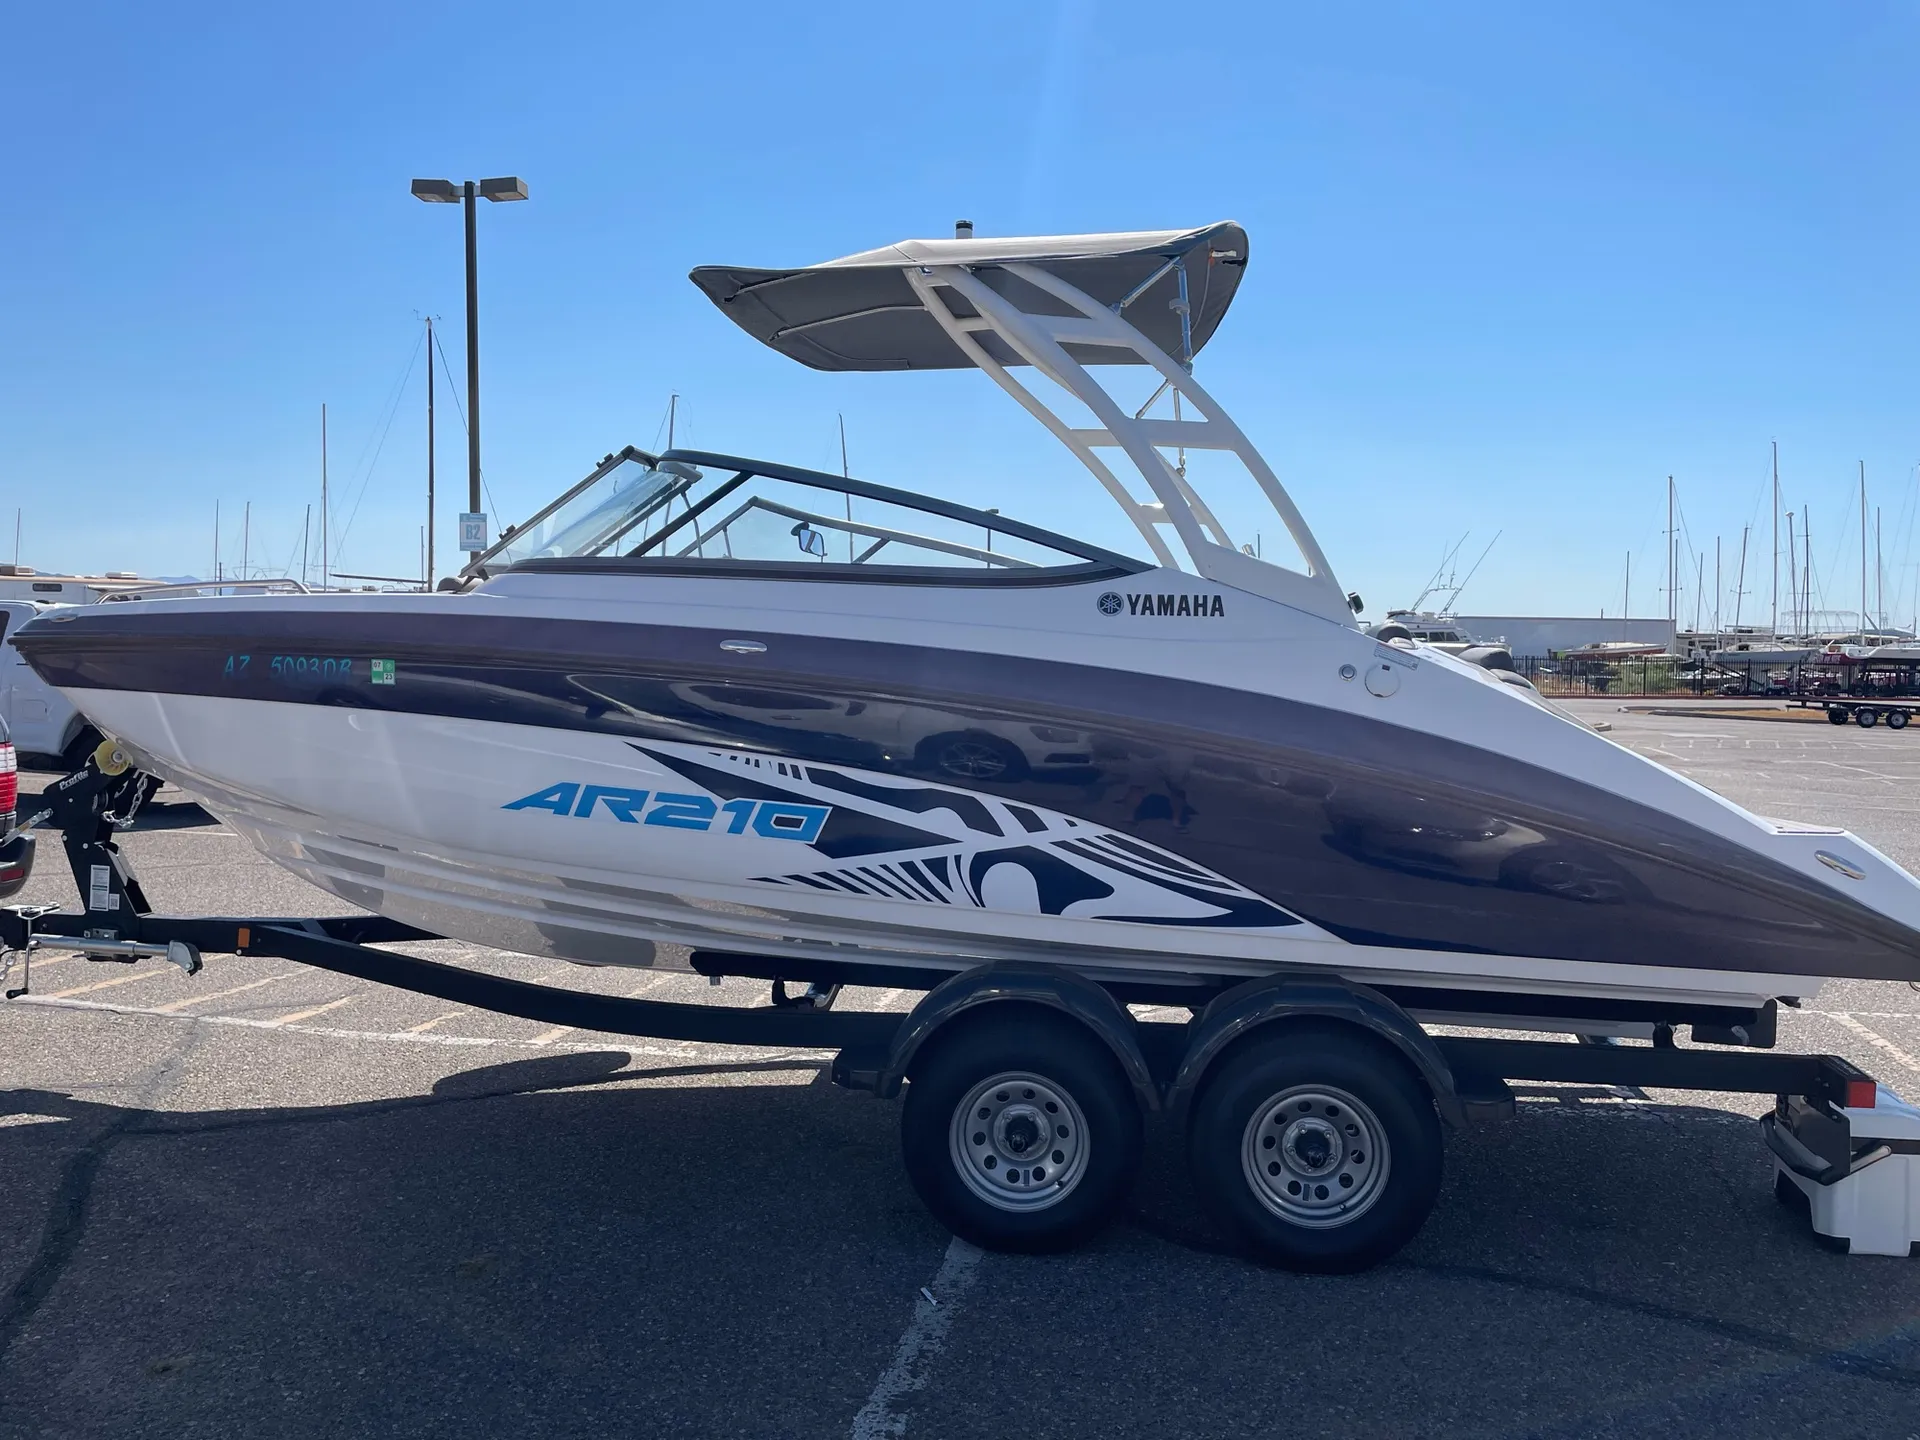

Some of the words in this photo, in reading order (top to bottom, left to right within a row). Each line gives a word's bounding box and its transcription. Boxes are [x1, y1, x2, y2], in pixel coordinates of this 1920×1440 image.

[465, 523, 481, 540] B2
[1126, 593, 1225, 617] YAMAHA
[500, 781, 833, 845] AR210
